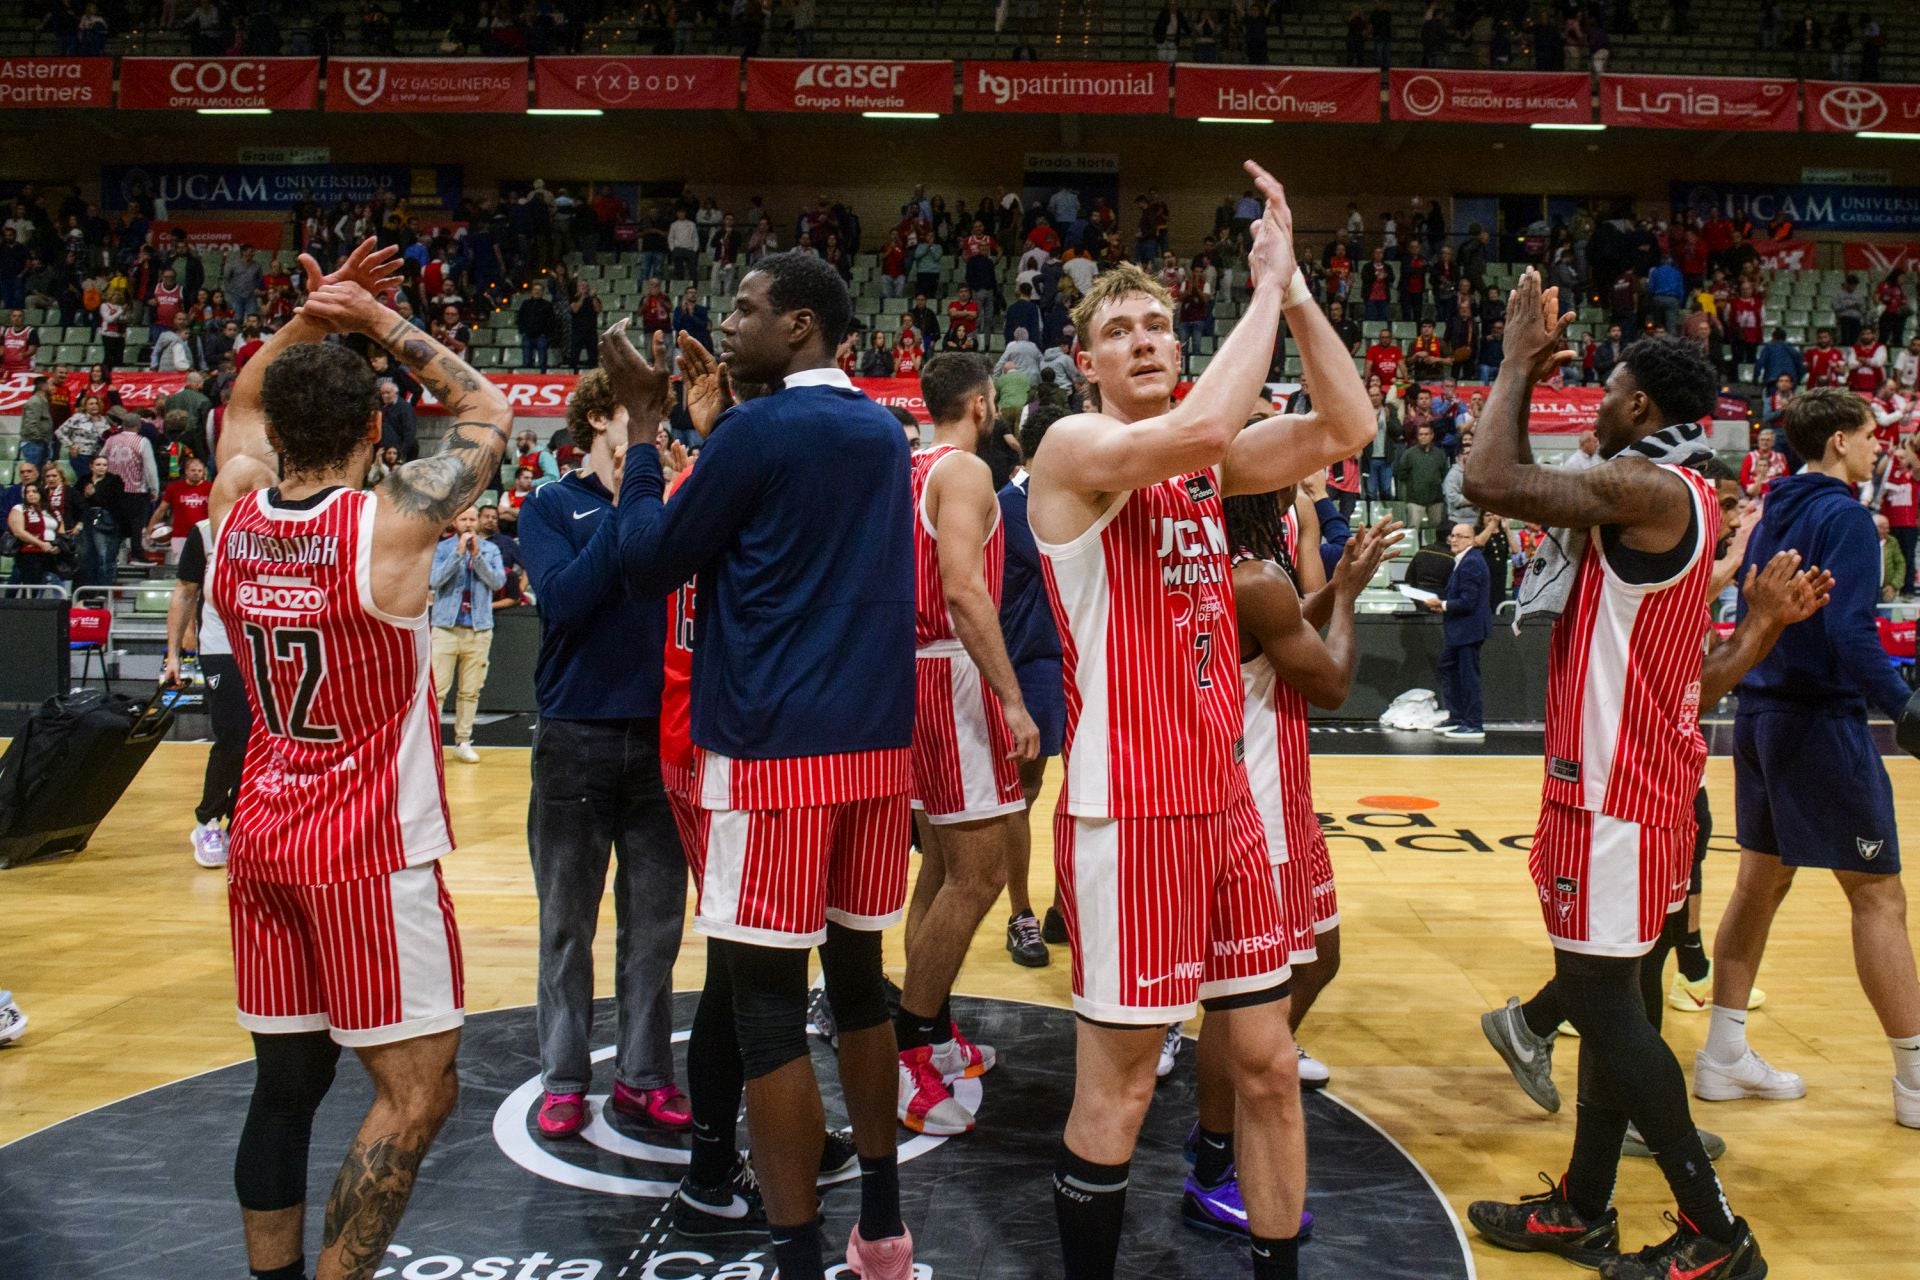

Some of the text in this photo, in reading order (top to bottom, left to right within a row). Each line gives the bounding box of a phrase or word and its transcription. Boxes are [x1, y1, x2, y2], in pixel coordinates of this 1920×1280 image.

[1, 61, 82, 80] Asterra
[817, 64, 905, 89] caser
[391, 76, 512, 91] V2 GASOLINERAS
[0, 84, 93, 102] Partners
[795, 94, 905, 108] Grupo Helvetia
[1451, 93, 1578, 109] REGIÓN DE MURCIA
[158, 175, 269, 202] UCAM
[275, 175, 393, 189] UNIVERSIDAD
[158, 232, 233, 241] Corucciones
[227, 531, 339, 566] RADEBAUGH
[1194, 632, 1213, 689] 2
[242, 620, 344, 743] 12
